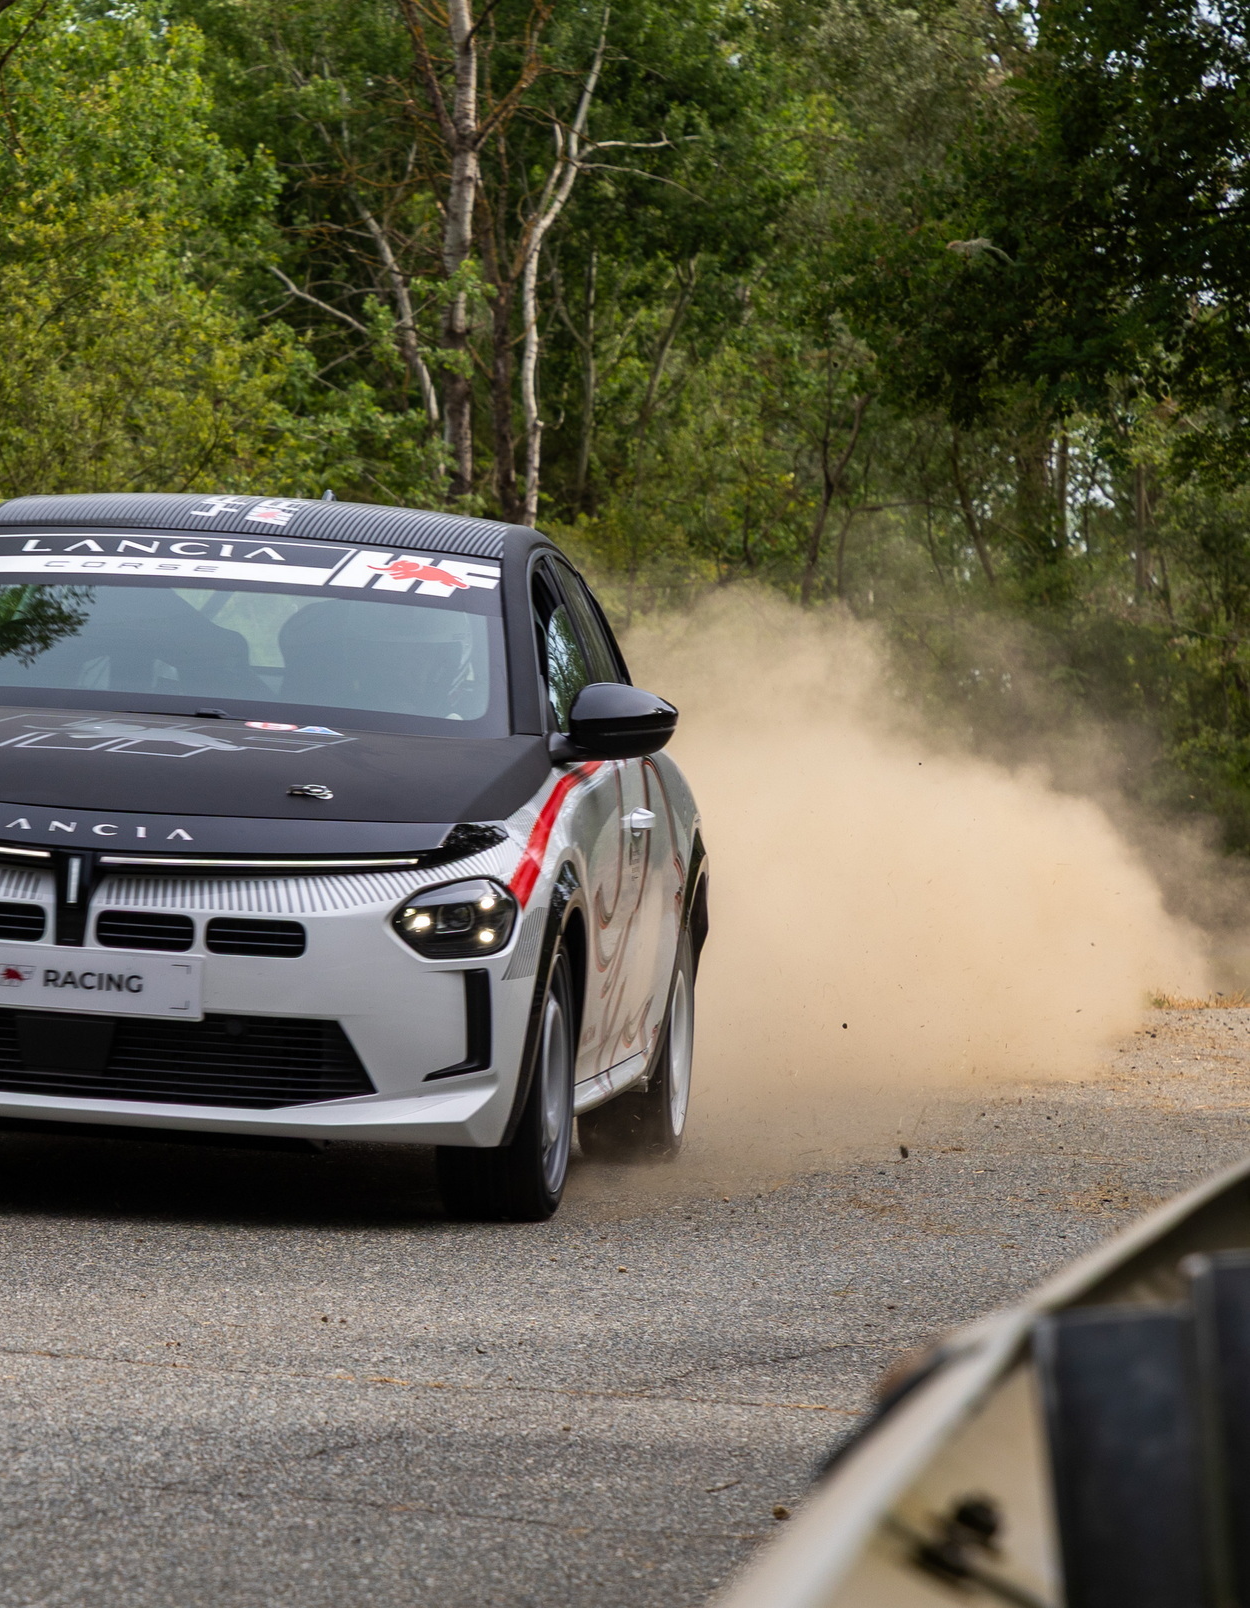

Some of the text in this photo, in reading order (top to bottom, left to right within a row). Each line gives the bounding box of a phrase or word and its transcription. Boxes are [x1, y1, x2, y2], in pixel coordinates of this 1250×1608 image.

[21, 538, 286, 561] LANCIA
[43, 560, 220, 573] CORSE
[42, 969, 144, 993] RACING
